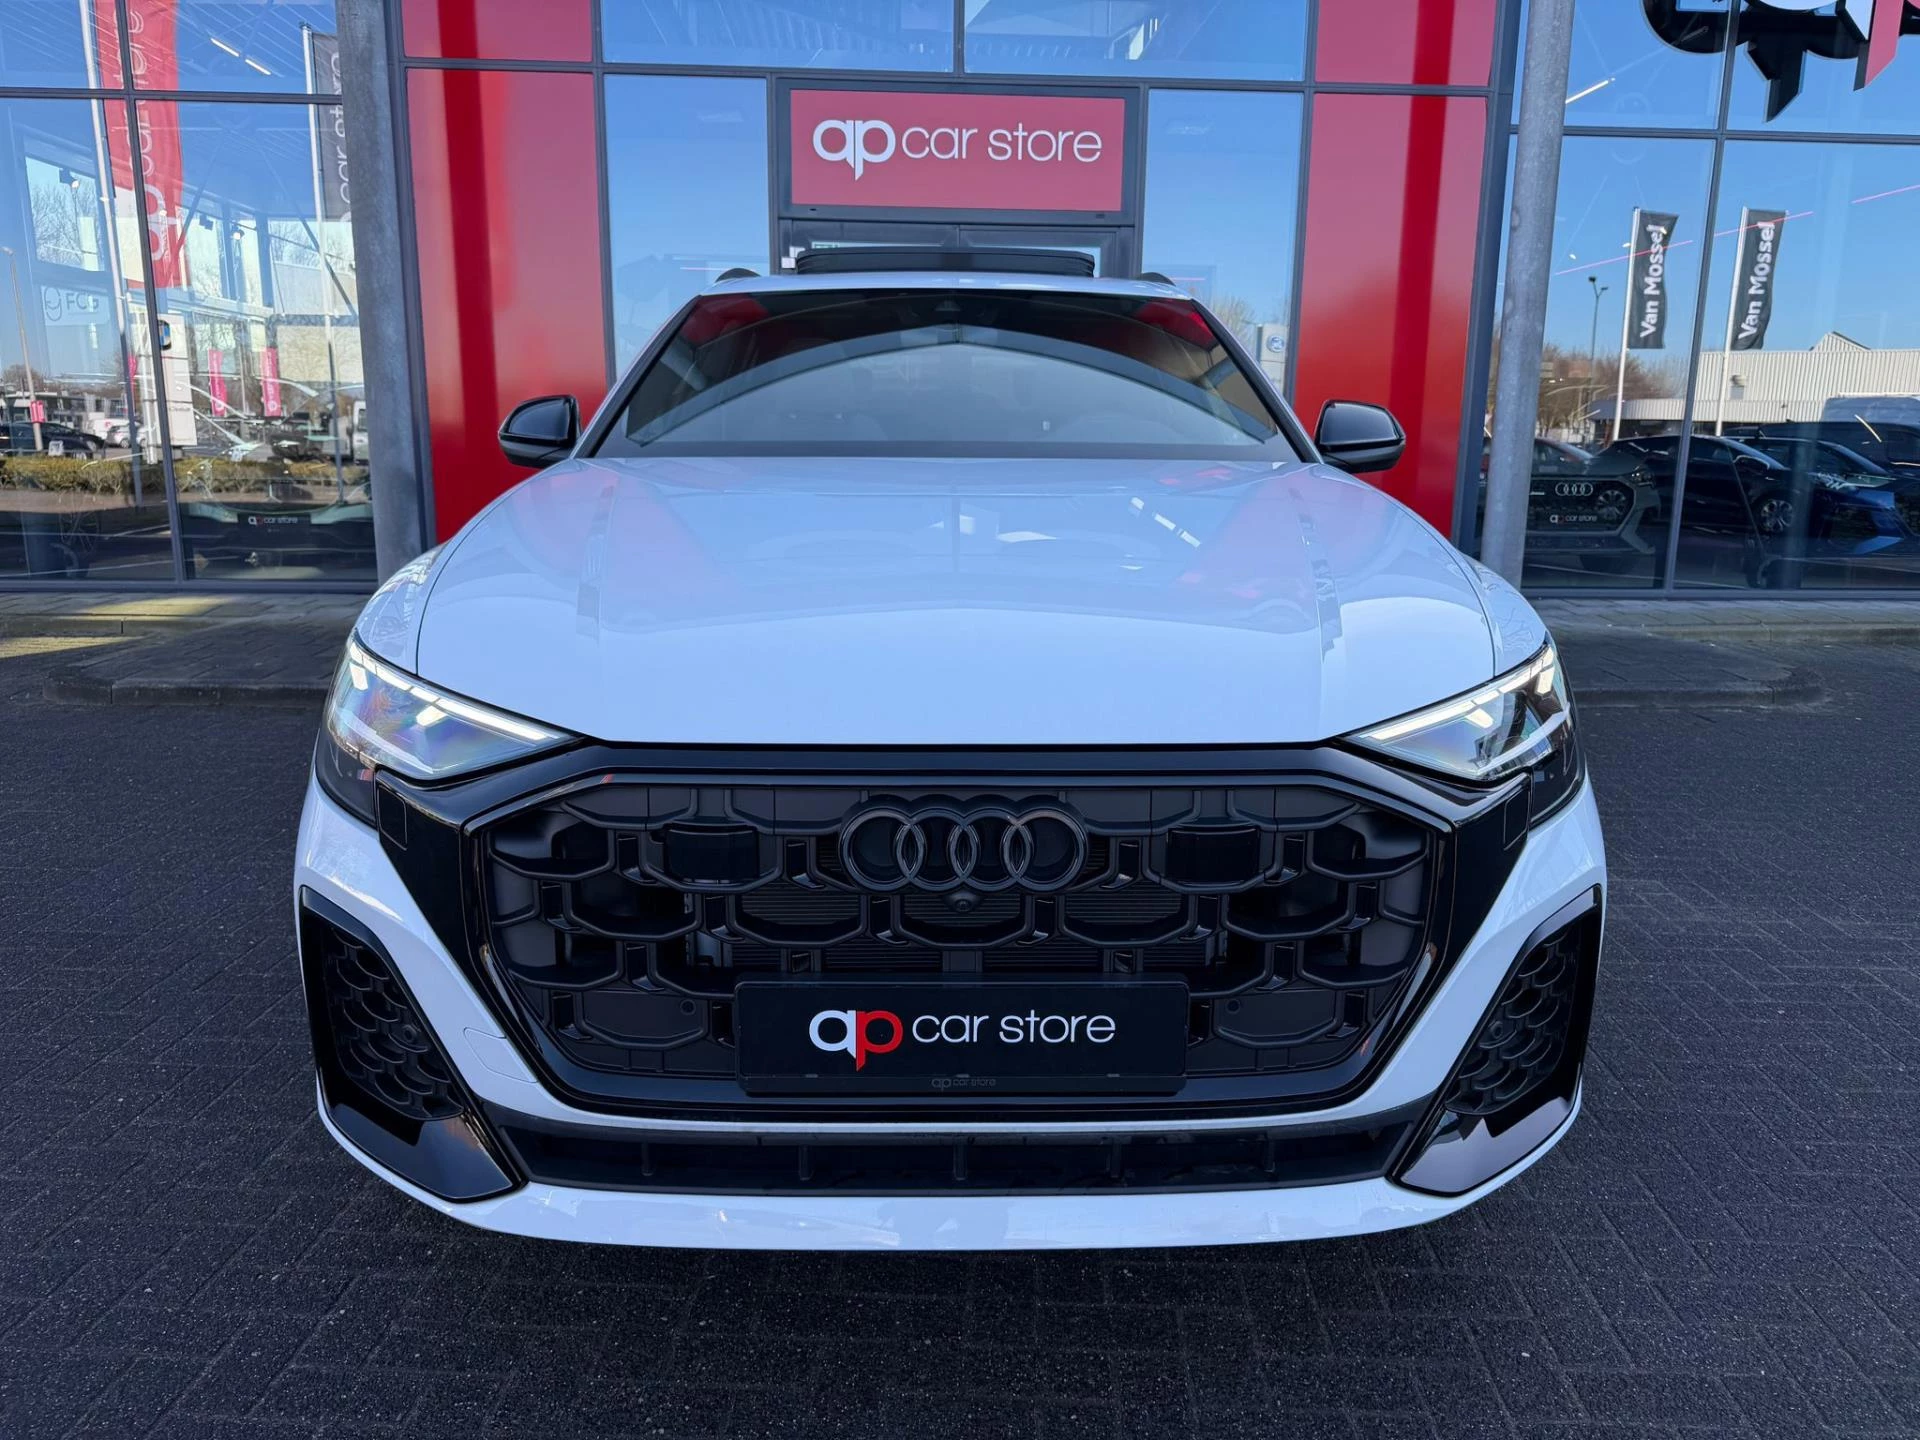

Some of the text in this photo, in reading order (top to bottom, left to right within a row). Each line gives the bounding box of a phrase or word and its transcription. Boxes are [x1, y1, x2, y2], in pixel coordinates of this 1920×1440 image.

[902, 127, 978, 160] car
[987, 122, 1102, 163] store
[1639, 224, 1667, 338] Van Mossel
[1737, 221, 1775, 339] Van Mossel
[912, 1014, 989, 1043] car
[999, 1009, 1116, 1043] store
